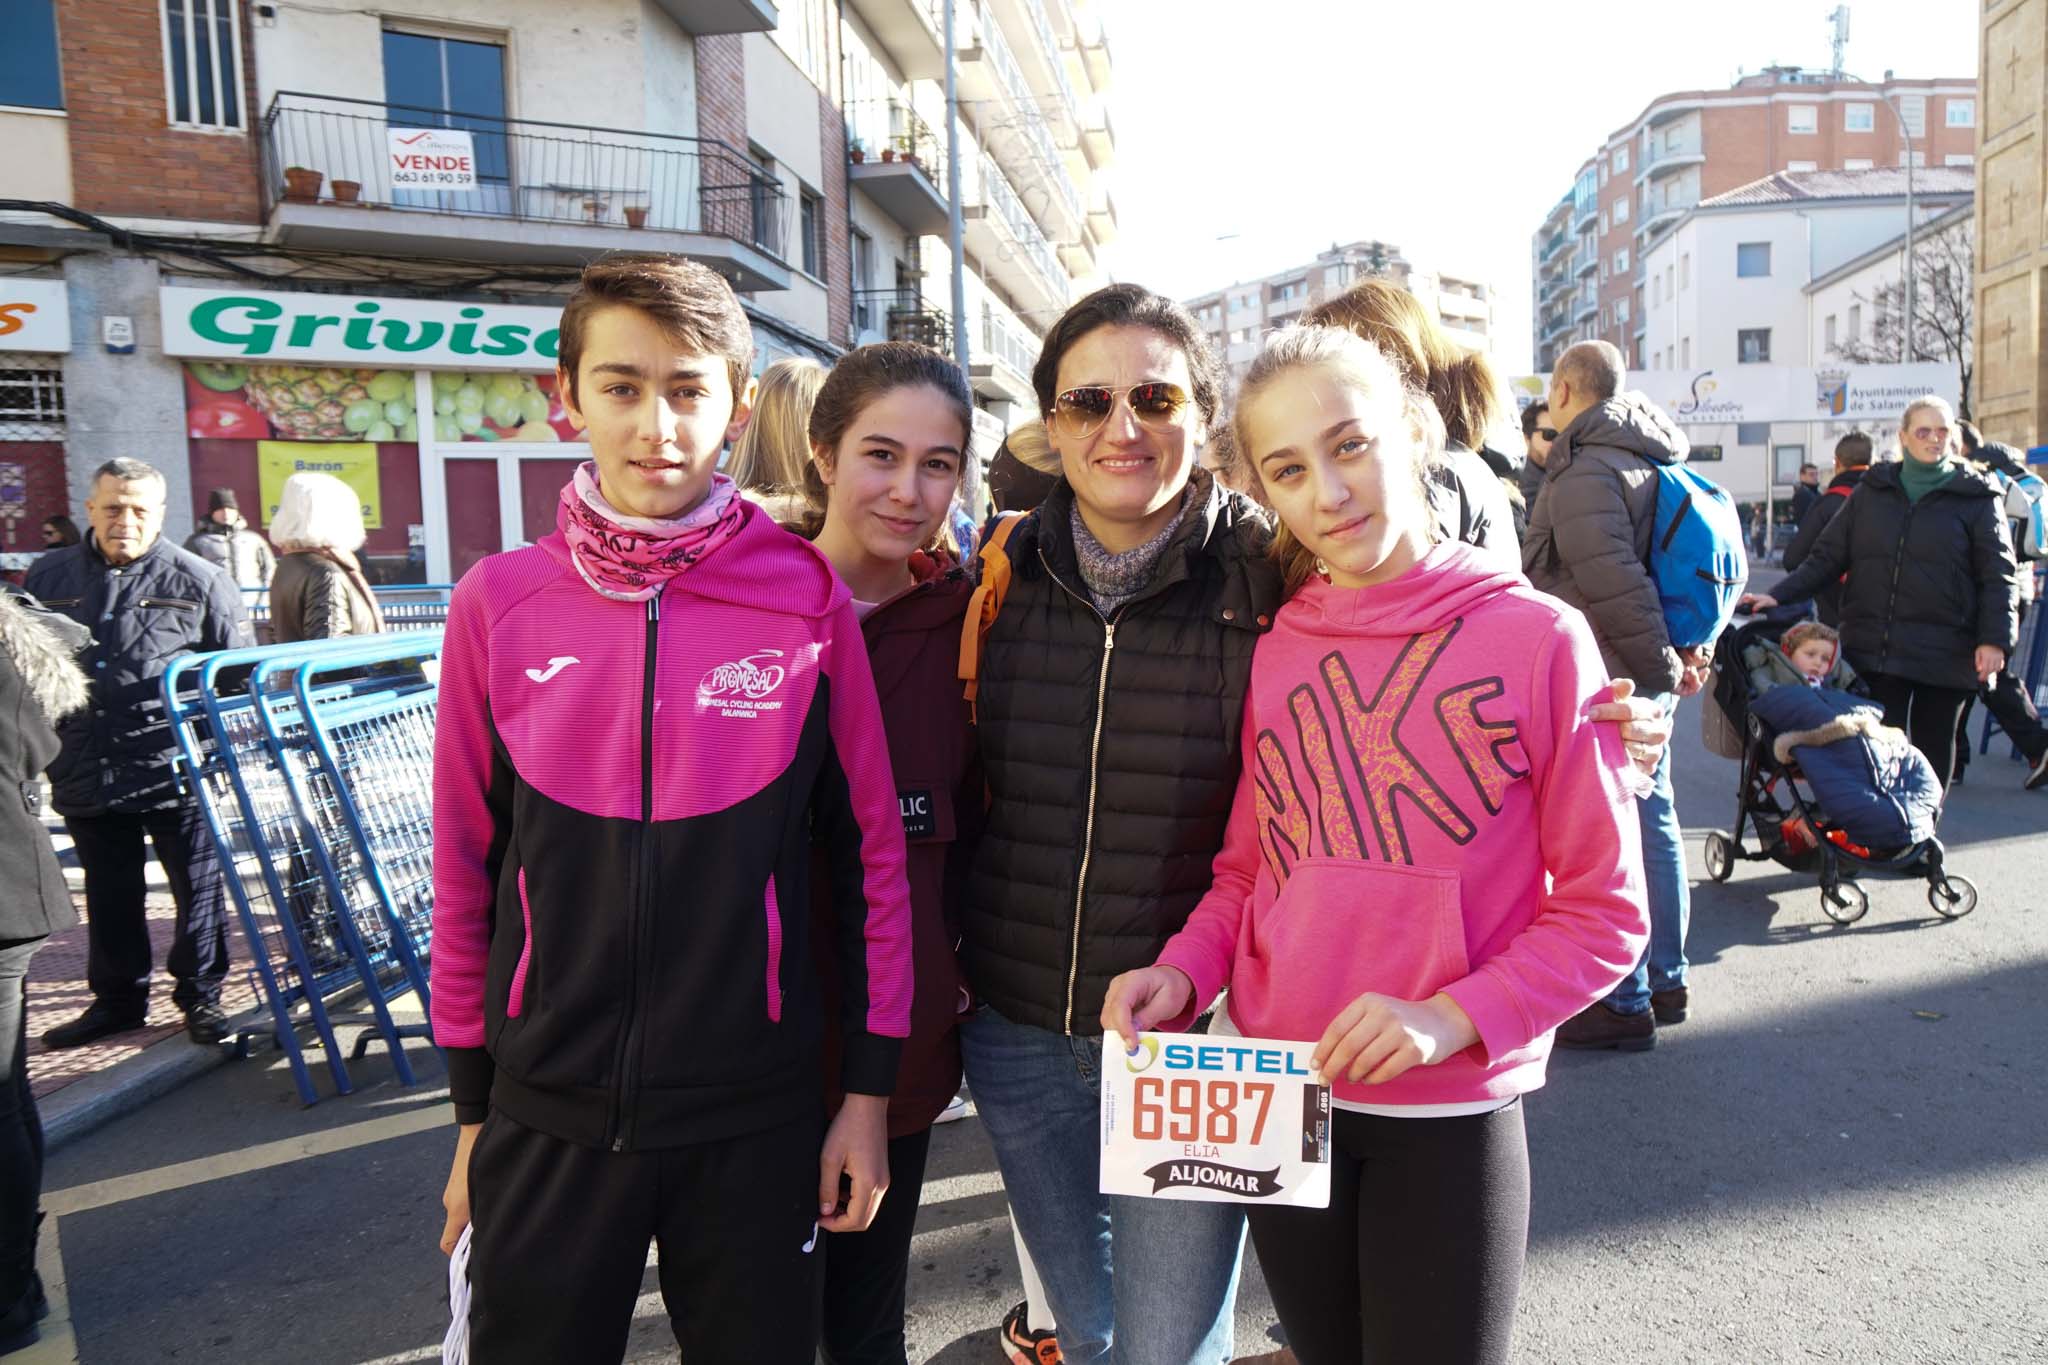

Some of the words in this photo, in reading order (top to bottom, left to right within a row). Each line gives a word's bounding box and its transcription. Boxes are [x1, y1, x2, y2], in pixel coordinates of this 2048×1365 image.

[393, 154, 470, 171] VENDE
[395, 172, 417, 182] 663
[457, 173, 471, 184] 59
[1851, 386, 1934, 398] Ayuntamiento
[1850, 400, 1864, 411] de
[1870, 400, 1905, 410] Salam
[712, 669, 773, 691] PROMESAL
[1254, 616, 1531, 899] NIKE
[1164, 1044, 1309, 1076] SETEL
[1133, 1076, 1275, 1146] 6987
[1183, 1144, 1220, 1158] ELIA
[1168, 1164, 1260, 1193] ALJOMAR
